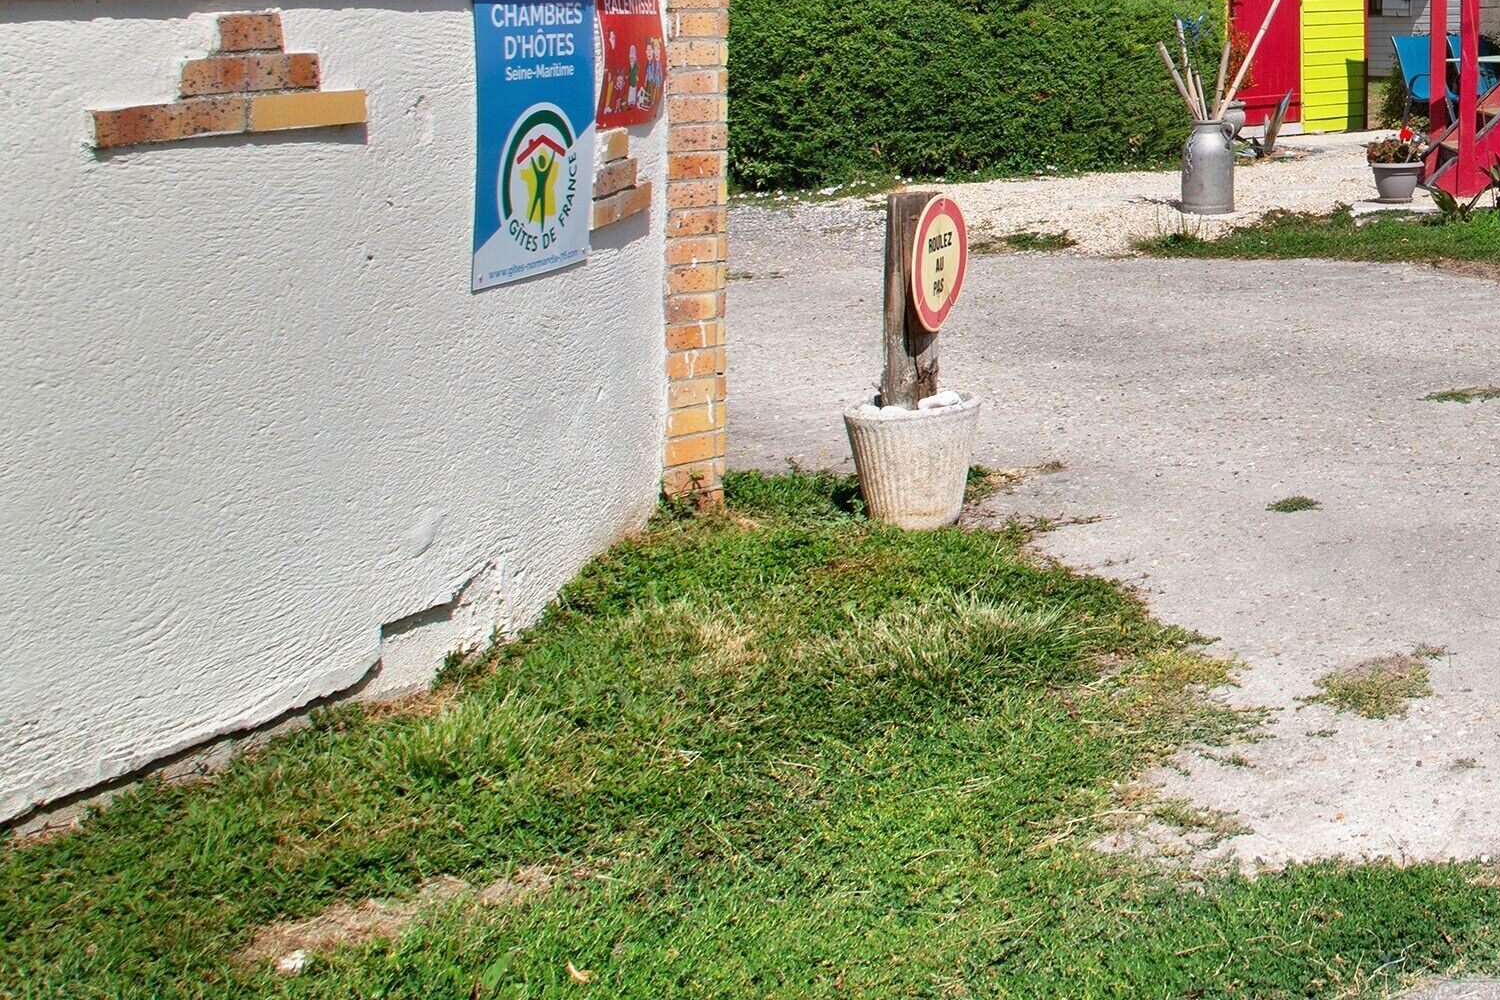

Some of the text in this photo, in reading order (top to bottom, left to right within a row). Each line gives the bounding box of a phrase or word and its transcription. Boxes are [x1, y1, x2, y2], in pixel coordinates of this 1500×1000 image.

[491, 2, 583, 28] CHAMBRES
[503, 28, 575, 60] D'HÔTES
[505, 62, 575, 82] Seine-Maritime
[509, 152, 578, 252] GÎTES DE FRANCE
[928, 231, 953, 254] ROULEZ
[935, 256, 945, 273] AU
[933, 277, 944, 297] PAS
